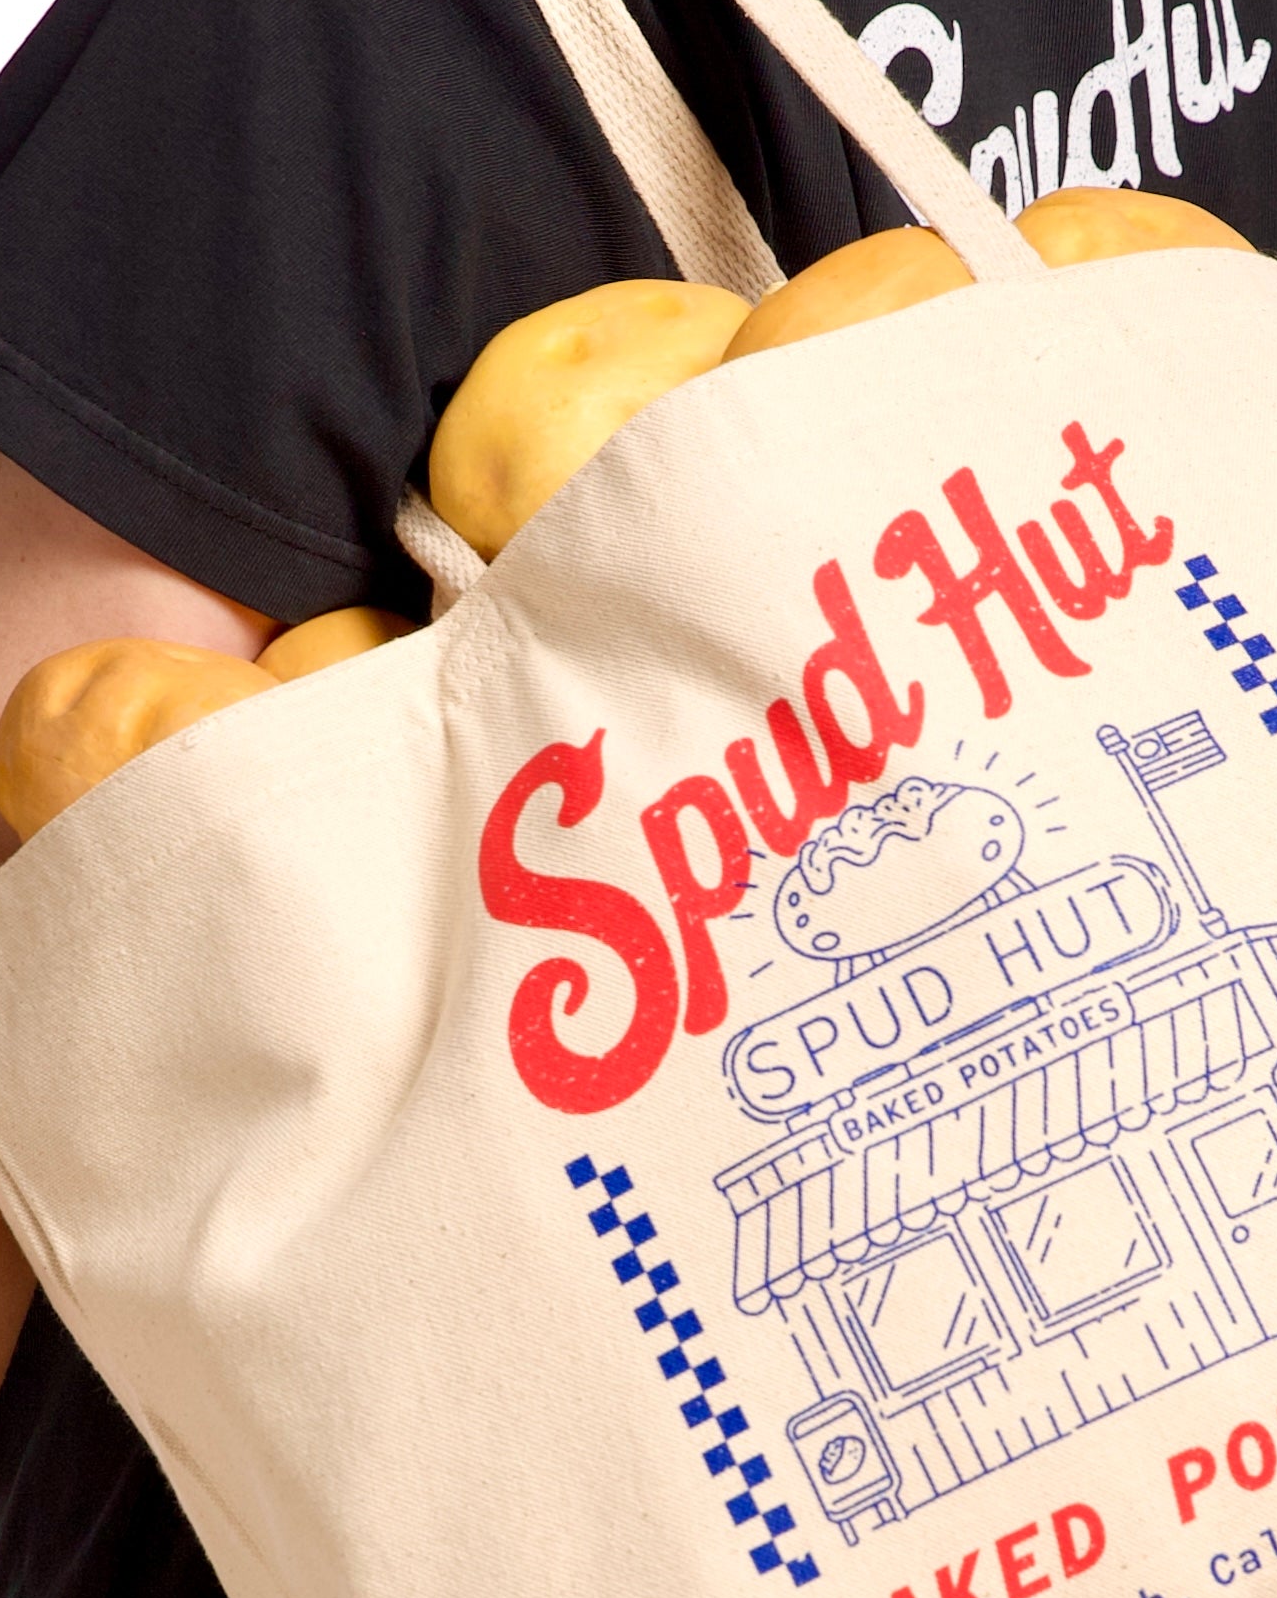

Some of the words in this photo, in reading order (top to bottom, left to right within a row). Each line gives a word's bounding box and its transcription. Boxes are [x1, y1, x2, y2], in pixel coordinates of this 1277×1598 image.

[478, 559, 924, 1115] Spud
[874, 421, 1174, 719] Hut
[746, 965, 954, 1101] SPUD
[984, 874, 1132, 987] HUT
[842, 1081, 944, 1142] BAKED
[958, 998, 1120, 1088] POTATOES
